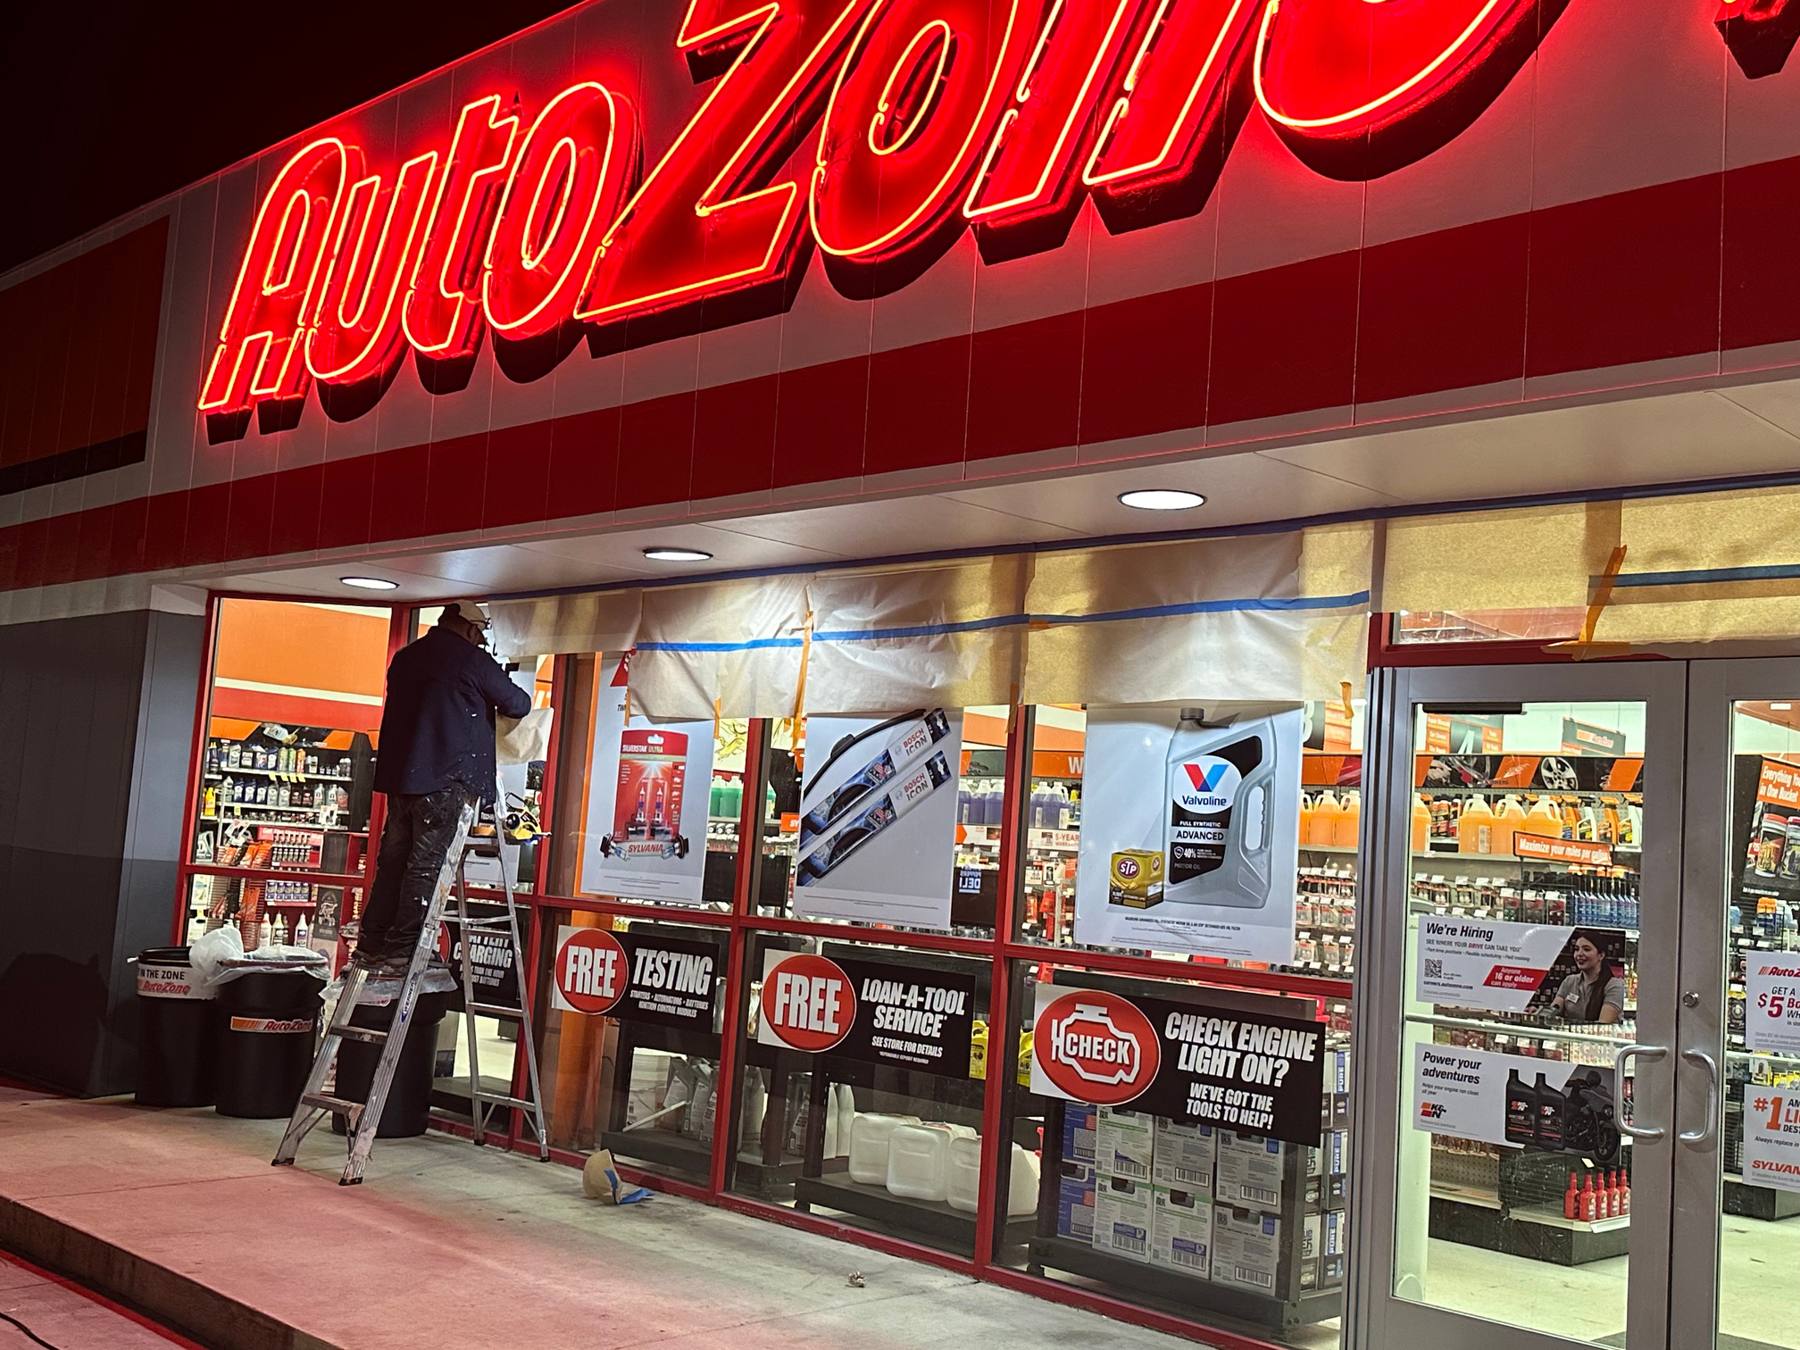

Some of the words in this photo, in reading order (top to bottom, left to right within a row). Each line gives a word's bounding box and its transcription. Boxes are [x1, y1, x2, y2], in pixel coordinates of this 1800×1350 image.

[903, 728, 925, 748] BOSCH
[905, 735, 928, 756] ICON
[904, 772, 926, 793] BOSCH
[906, 780, 929, 801] ICON
[1182, 795, 1227, 807] Valvoline
[1176, 830, 1224, 841] ADVANCED
[1519, 838, 1549, 852] Maximize
[628, 844, 664, 853] SYLVANIA
[1120, 861, 1137, 875] STP
[1426, 922, 1457, 936] We're
[1460, 925, 1494, 942] Hiring
[453, 942, 513, 969] CARGING
[1468, 942, 1484, 950] DRIVE
[146, 970, 159, 979] THE
[161, 970, 185, 981] ZONE
[564, 945, 618, 998] FREE
[632, 947, 714, 996] TESTING
[1494, 973, 1503, 981] 16
[1513, 975, 1535, 984] older
[142, 980, 191, 995] AutoZone
[1771, 986, 1788, 996] GET
[1789, 987, 1796, 996] A
[773, 971, 842, 1035] FREE
[1758, 993, 1785, 1018] $5
[872, 1035, 883, 1048] SEE
[883, 1037, 903, 1050] STORE
[904, 1040, 916, 1052] FOR
[916, 1042, 943, 1058] DETAILS
[1165, 1012, 1236, 1049] CHECK
[1236, 1022, 1319, 1062] ENGINE
[1065, 1032, 1131, 1065] CHECK
[1177, 1043, 1241, 1079] LIGHT
[1241, 1053, 1290, 1088] ON?
[1422, 1051, 1456, 1066] Power
[1457, 1057, 1482, 1071] your
[1422, 1067, 1480, 1085] adventures
[1190, 1082, 1224, 1103] WE'VE
[1224, 1088, 1249, 1107] GOT
[1250, 1092, 1274, 1113] THE
[1186, 1098, 1221, 1120] TOOLS
[1221, 1104, 1239, 1123] TO
[1239, 1107, 1274, 1130] HELP!
[1753, 1096, 1783, 1131] #1
[1784, 1108, 1800, 1125] LI
[1755, 1135, 1773, 1145] Always
[1774, 1138, 1794, 1147] replace
